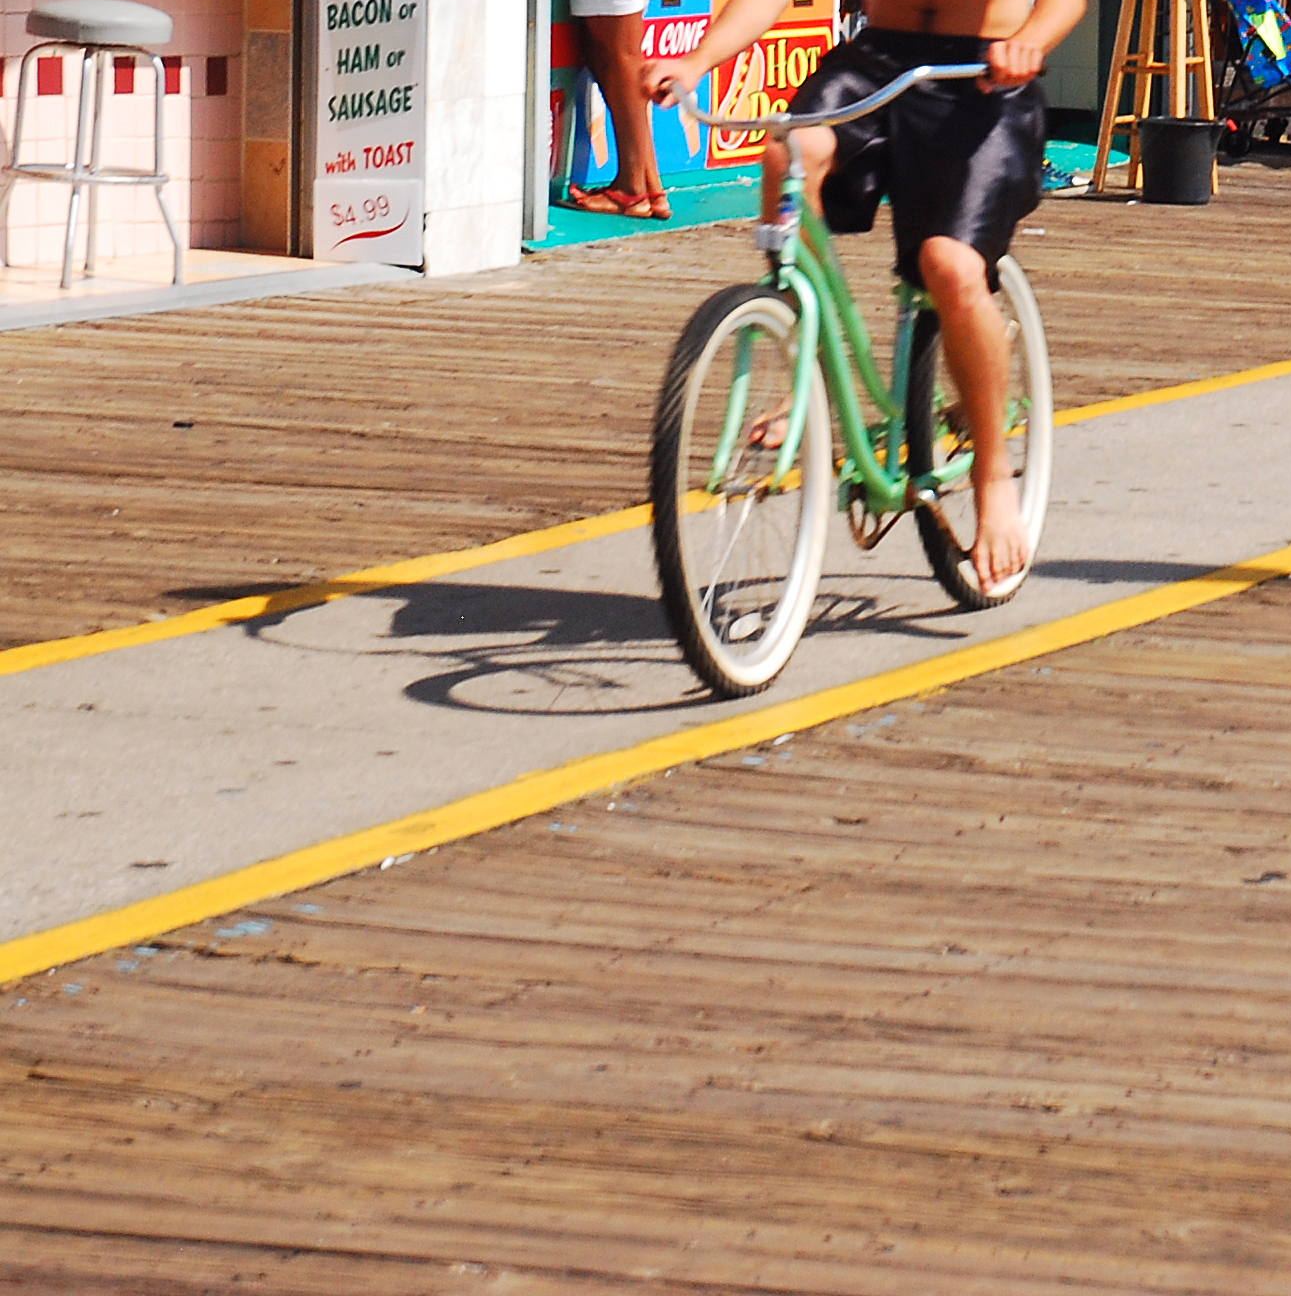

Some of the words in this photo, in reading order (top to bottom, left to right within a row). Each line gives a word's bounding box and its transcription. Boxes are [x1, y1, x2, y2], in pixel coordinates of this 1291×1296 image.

[398, 1, 417, 20] or
[337, 44, 381, 75] HAM
[387, 48, 406, 68] or
[766, 39, 823, 90] HOT
[328, 85, 414, 122] SAUSAGE
[325, 149, 357, 175] with
[363, 141, 415, 170] TOAST
[330, 194, 391, 227] $4.99
